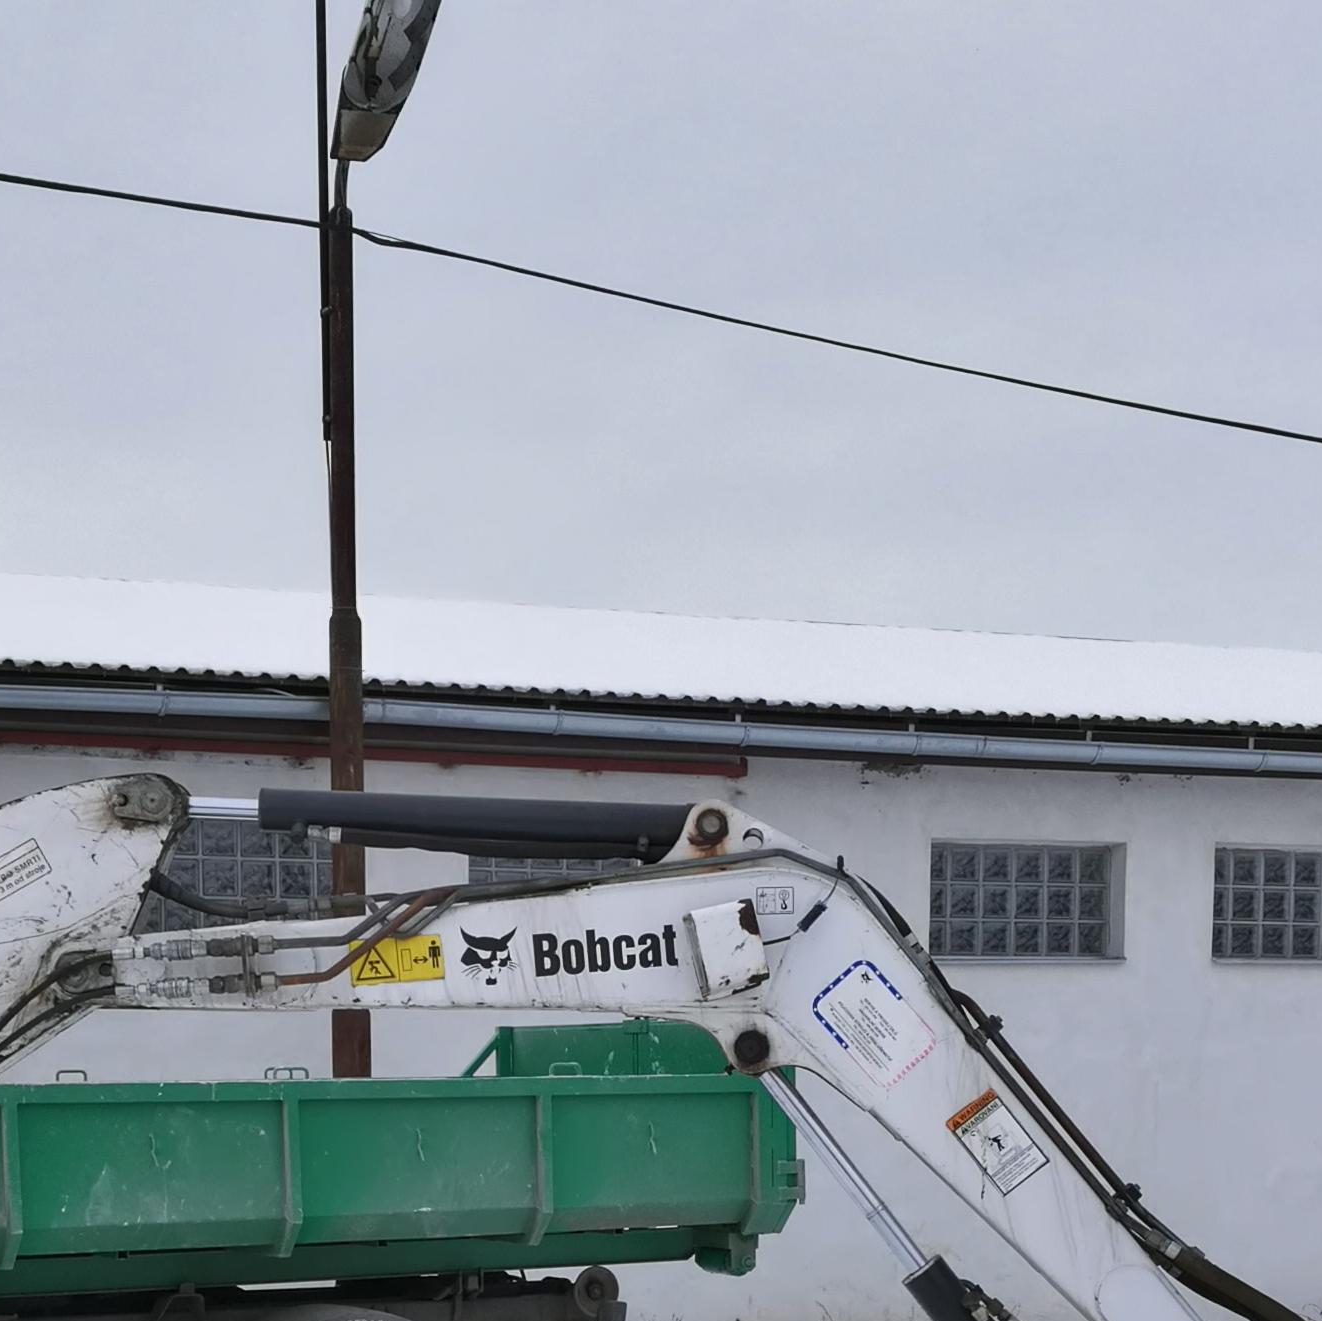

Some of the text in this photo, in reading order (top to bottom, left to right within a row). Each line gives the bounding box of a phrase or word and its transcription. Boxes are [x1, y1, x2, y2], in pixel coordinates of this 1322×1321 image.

[14, 855, 41, 874] SMRTI
[532, 924, 679, 977] Bobcat
[959, 1091, 994, 1120] WARNING
